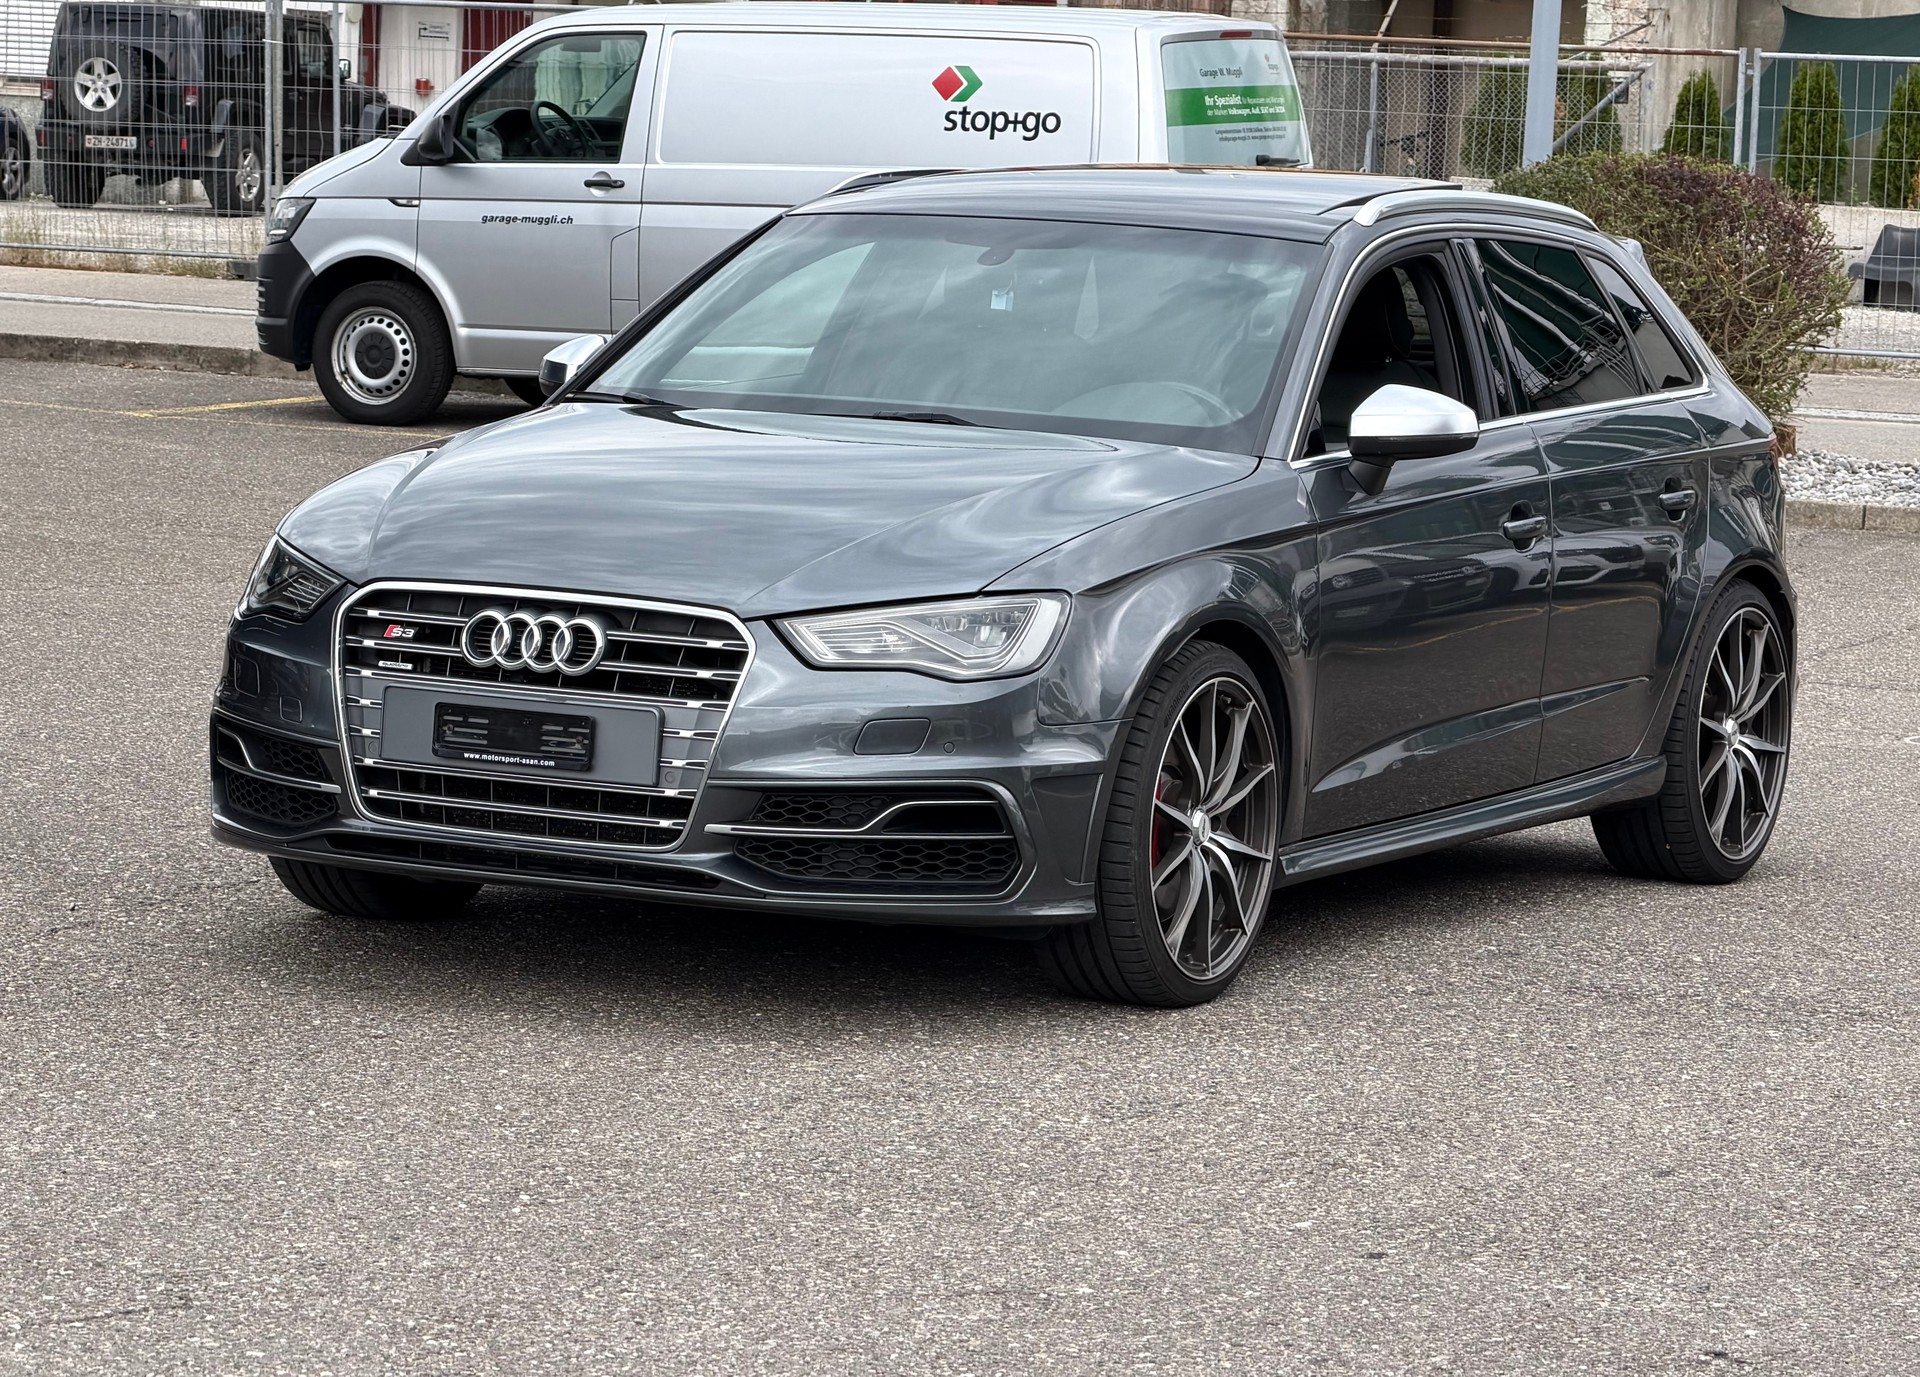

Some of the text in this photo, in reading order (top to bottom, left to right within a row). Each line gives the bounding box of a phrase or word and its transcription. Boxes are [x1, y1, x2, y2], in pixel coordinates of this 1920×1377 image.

[1199, 68, 1218, 79] Garage
[1204, 94, 1214, 106] Ihr
[1214, 94, 1242, 108] Spezialist
[943, 105, 1062, 142] stop+go
[481, 214, 574, 226] garage-muggli.ch
[390, 627, 415, 638] S3
[463, 752, 555, 767] www.motorsport-asan.com
